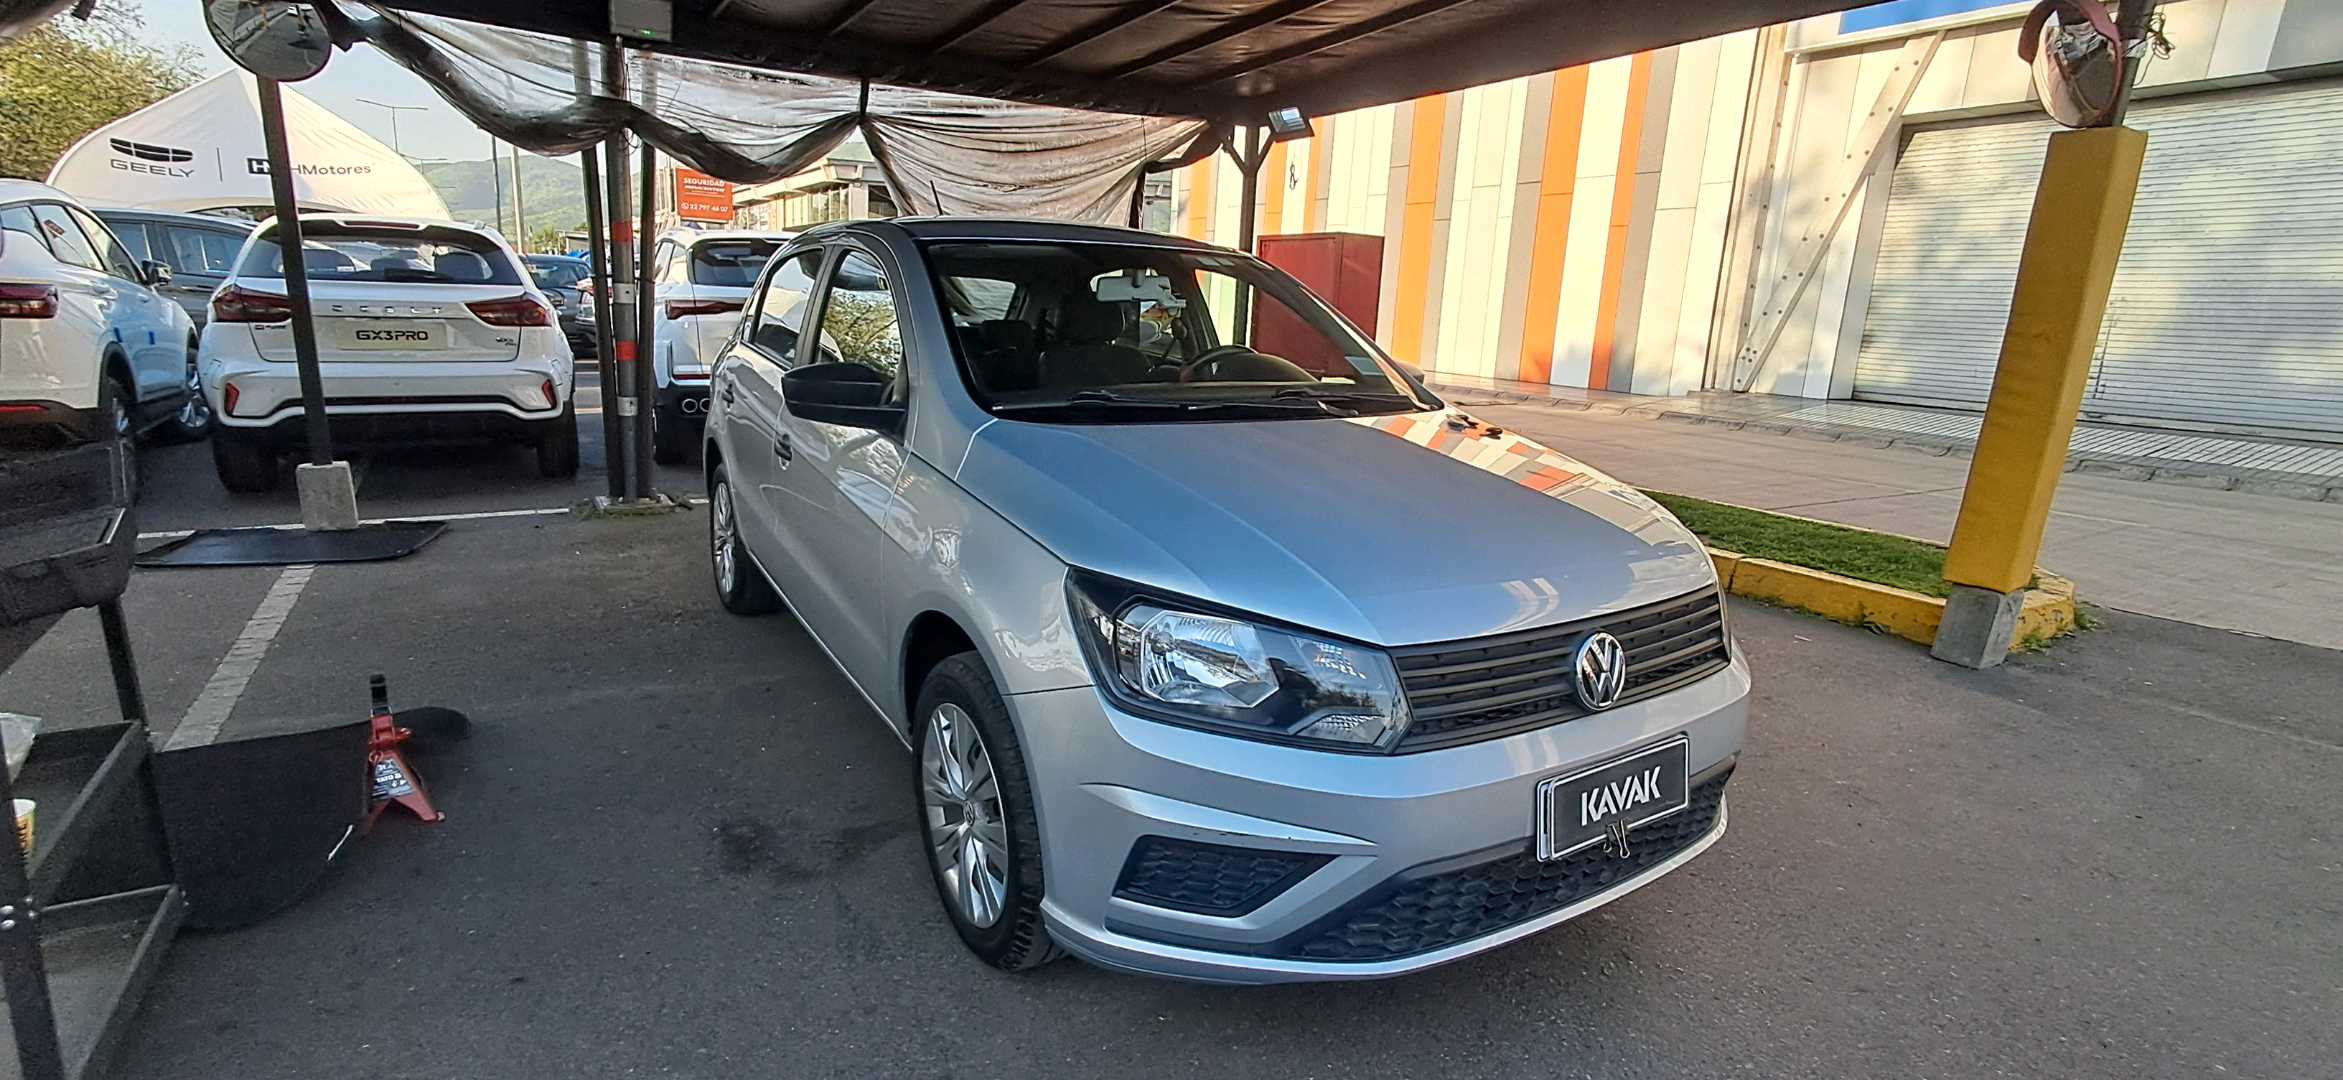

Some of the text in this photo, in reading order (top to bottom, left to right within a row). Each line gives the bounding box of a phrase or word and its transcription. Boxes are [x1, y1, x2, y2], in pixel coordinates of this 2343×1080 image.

[110, 159, 194, 178] GEELY
[684, 177, 725, 187] SEGURIDAD
[356, 330, 429, 341] GX3PRO
[1581, 765, 1663, 827] KAVAK
